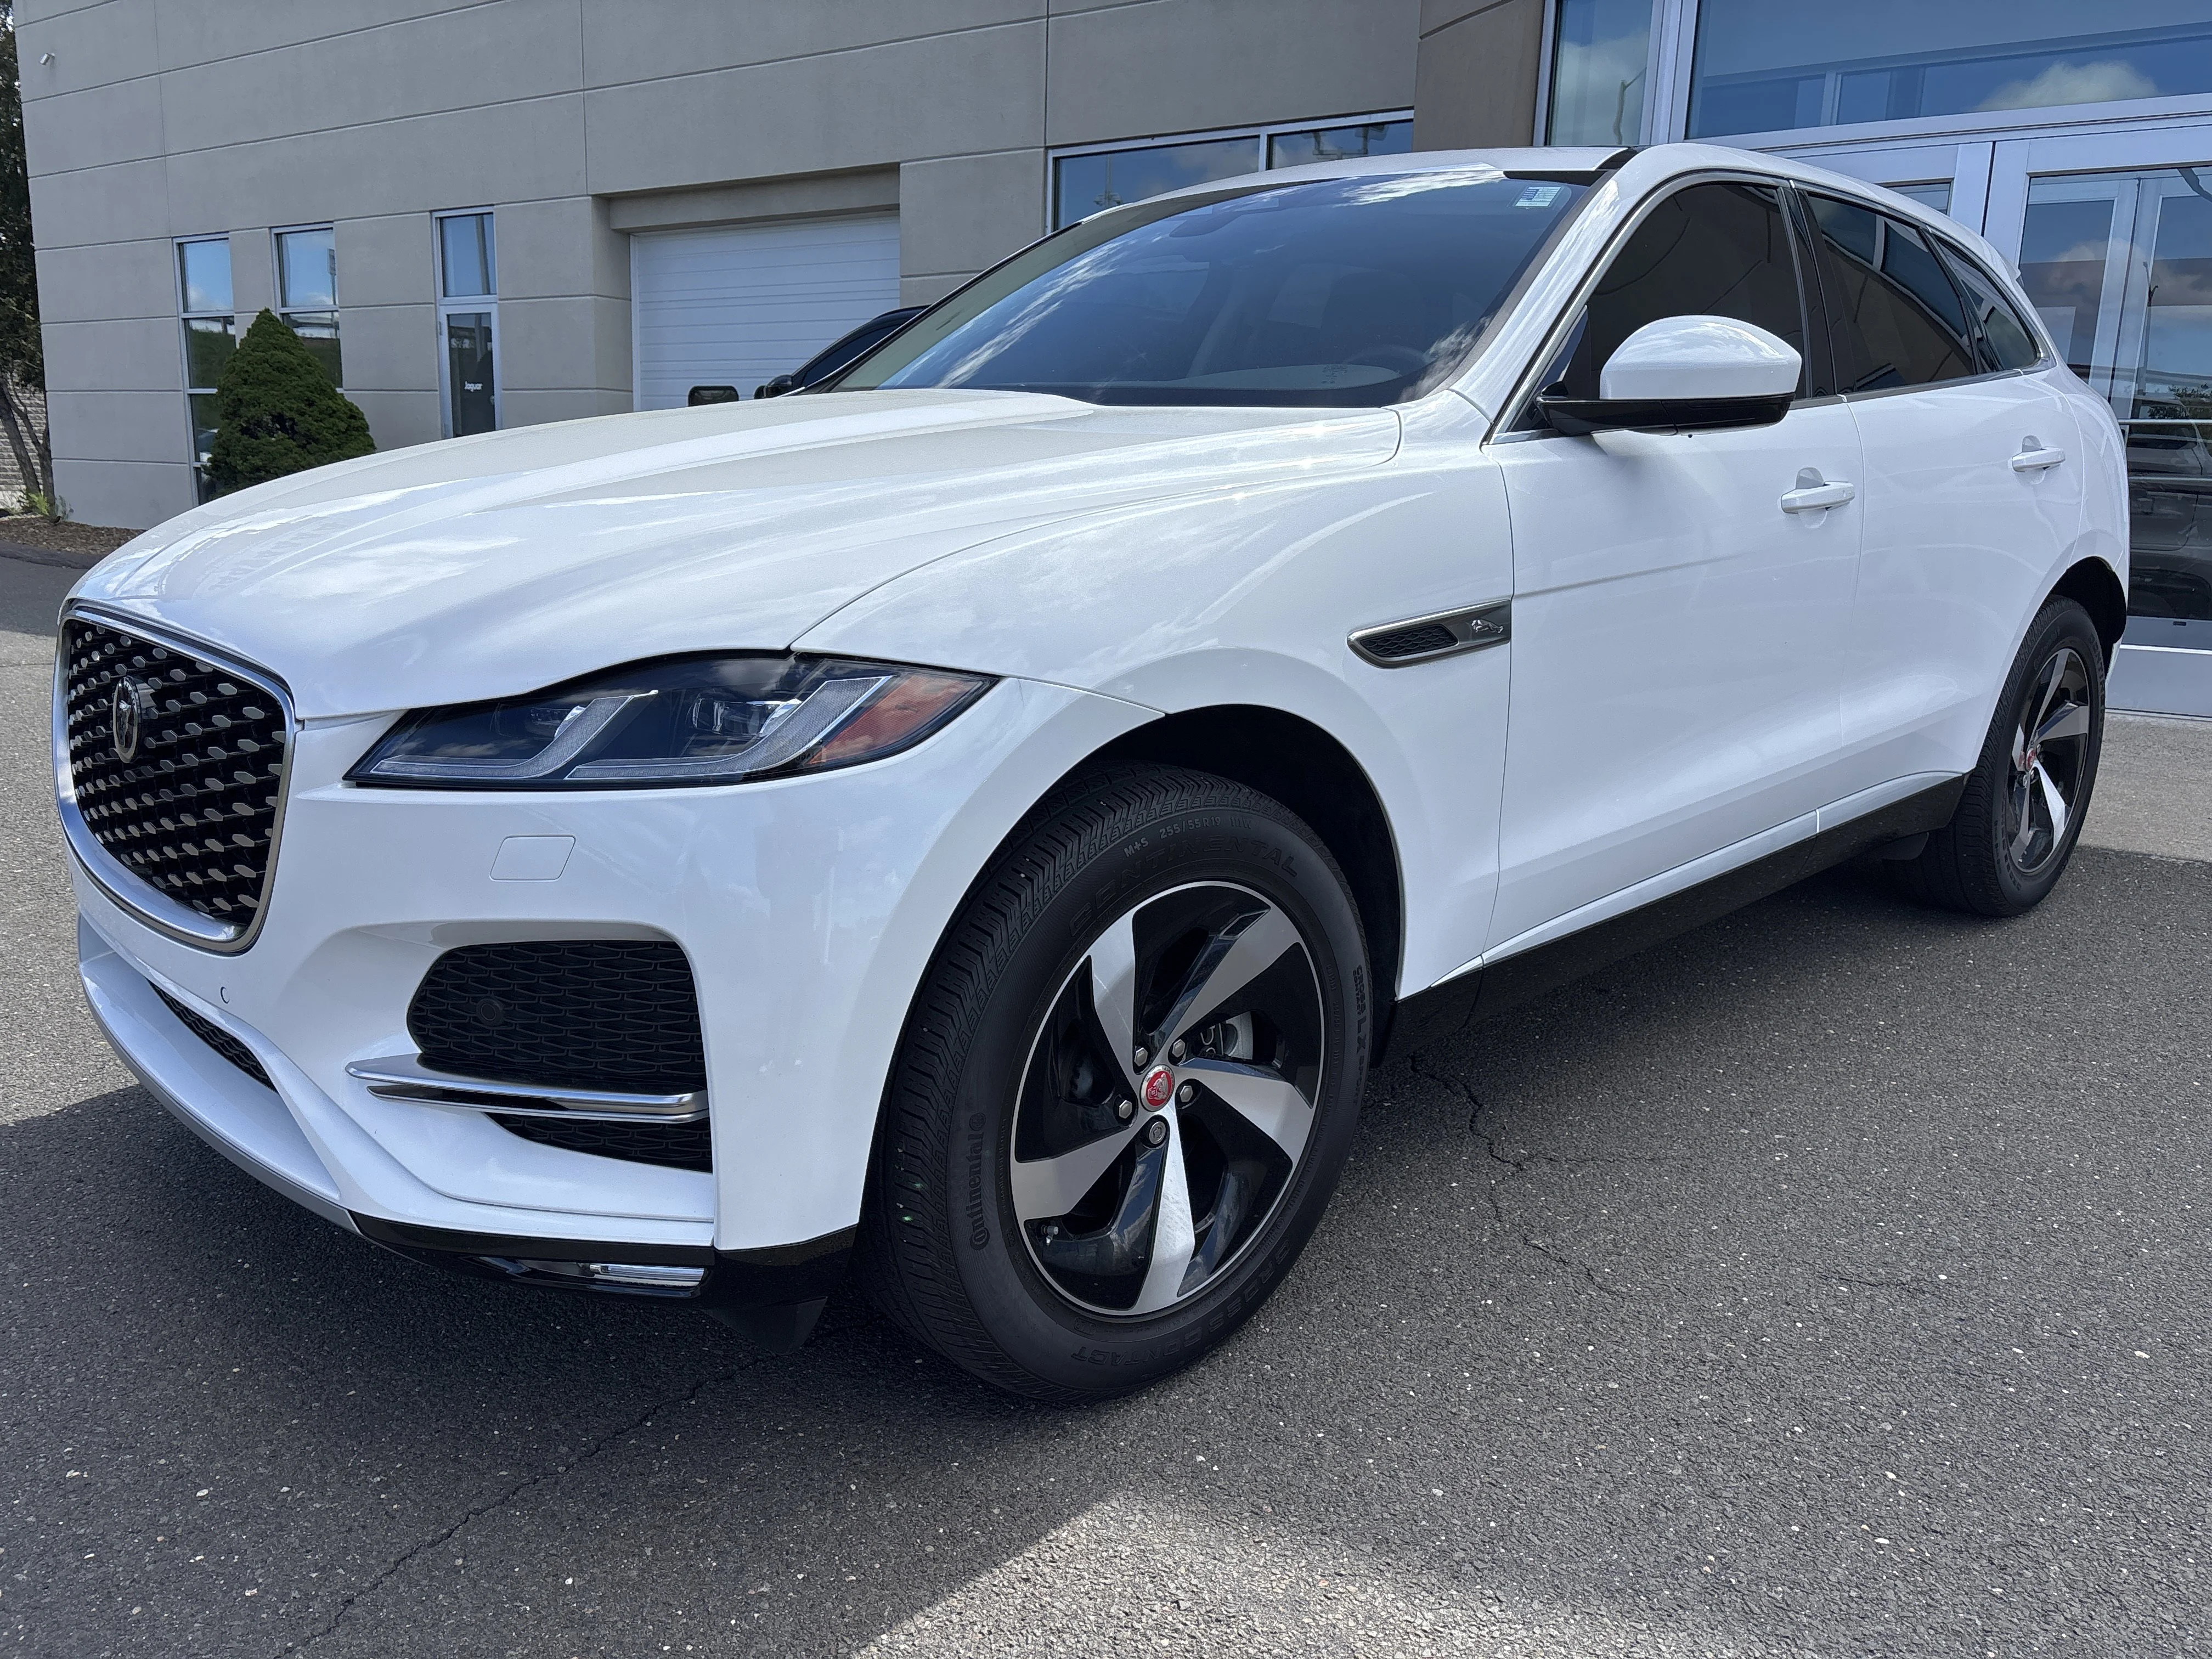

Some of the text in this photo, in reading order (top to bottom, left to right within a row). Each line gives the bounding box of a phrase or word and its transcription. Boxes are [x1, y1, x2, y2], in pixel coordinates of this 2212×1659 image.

[464, 381, 482, 392] Jaguar
[1124, 837, 1149, 857] M+S
[966, 1131, 990, 1251] Continental
